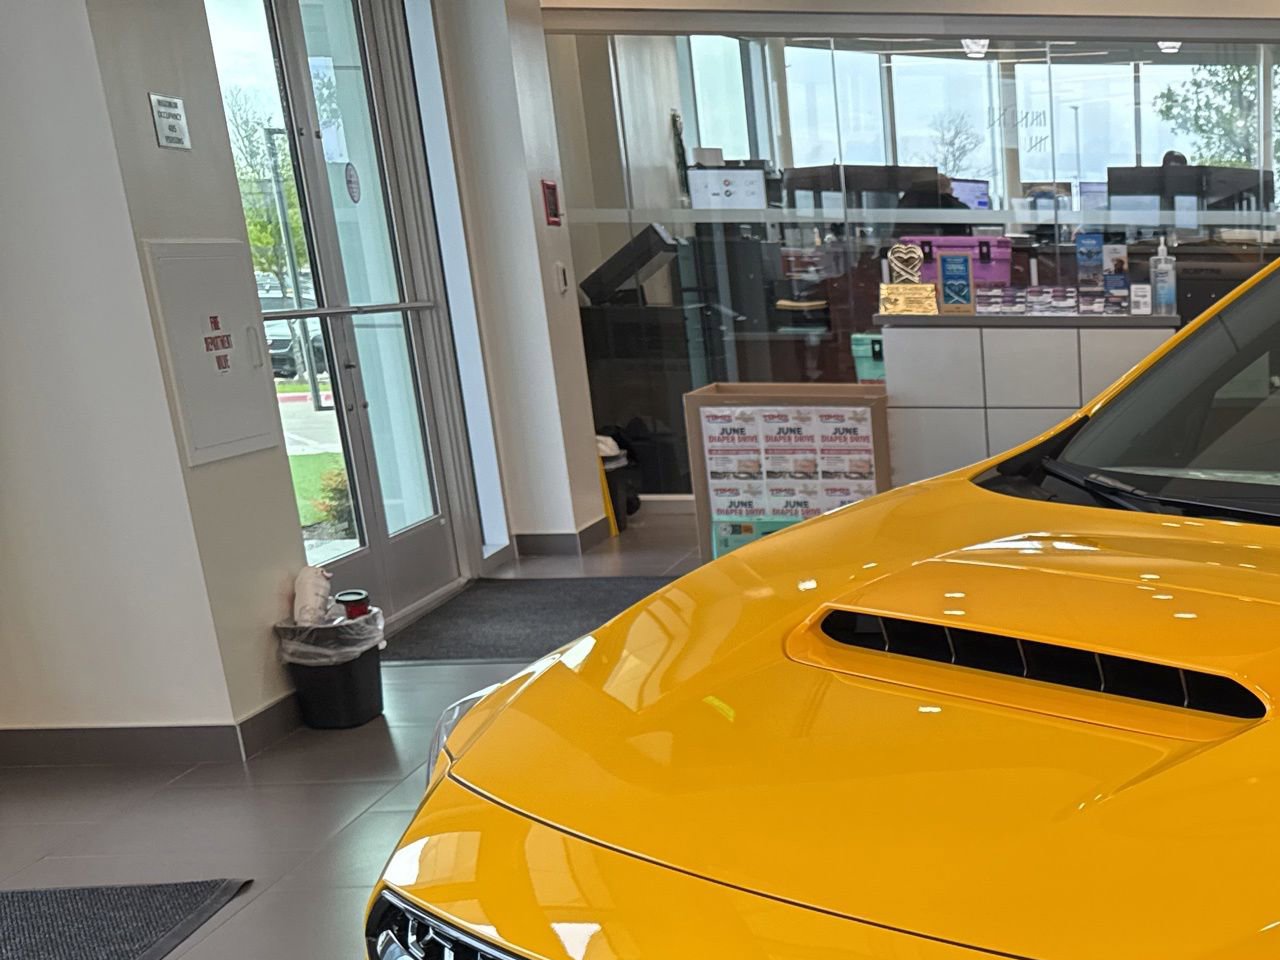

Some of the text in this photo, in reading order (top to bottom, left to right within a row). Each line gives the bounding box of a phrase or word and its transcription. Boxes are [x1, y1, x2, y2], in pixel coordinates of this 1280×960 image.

[720, 427, 746, 436] JUNE
[777, 427, 803, 436] JUNE
[832, 427, 859, 436] JUNE
[728, 500, 754, 509] JUNE
[783, 500, 809, 509] JUNE
